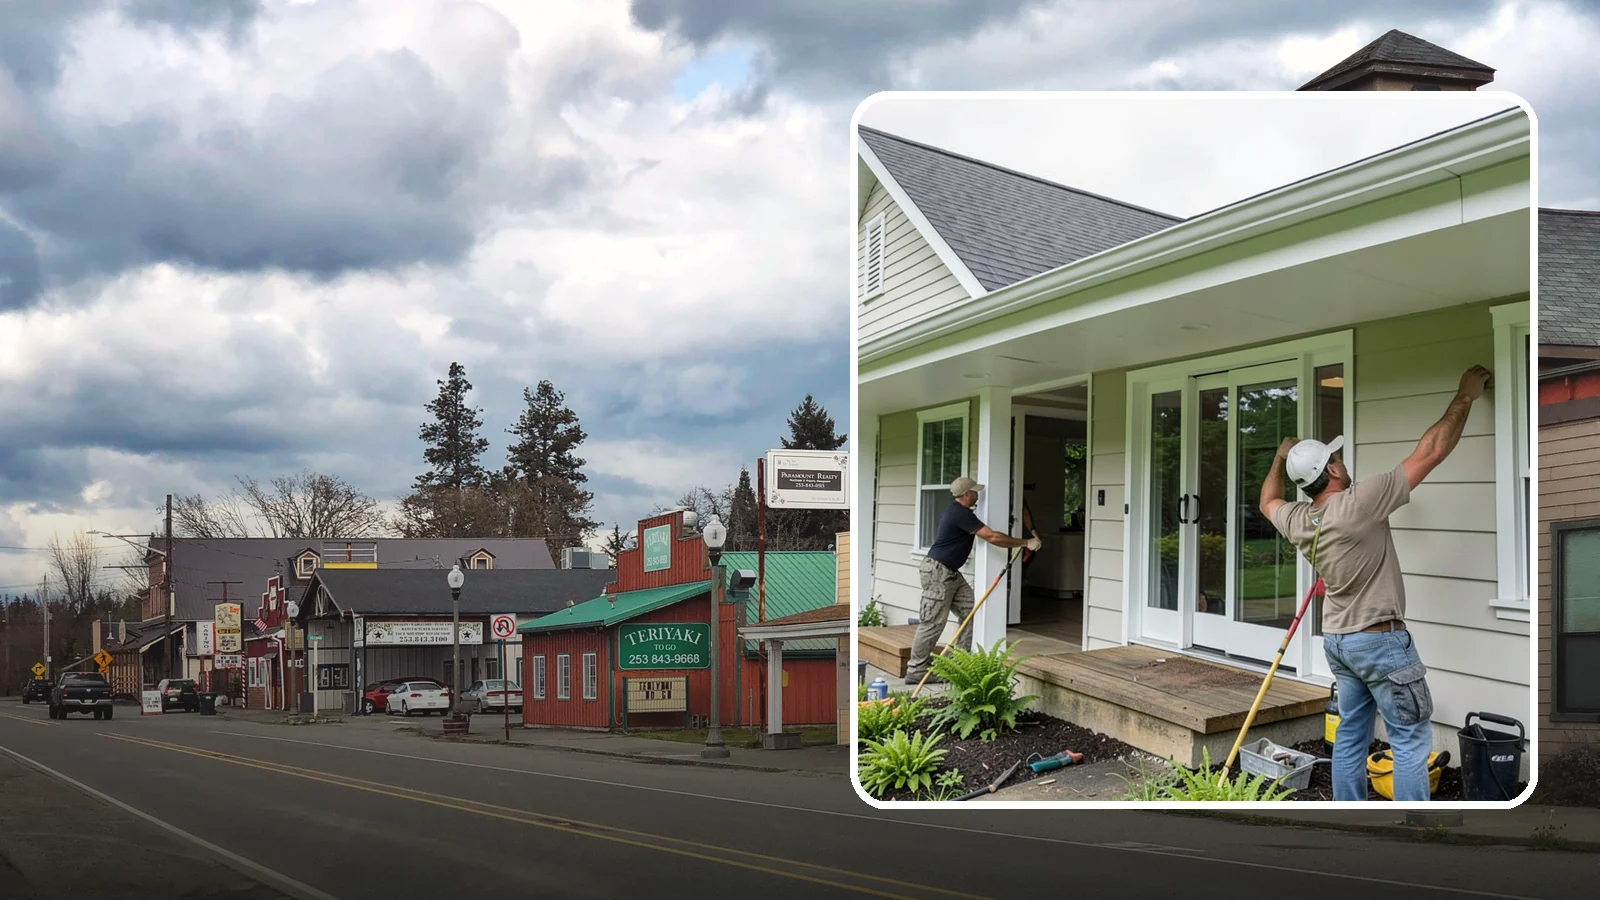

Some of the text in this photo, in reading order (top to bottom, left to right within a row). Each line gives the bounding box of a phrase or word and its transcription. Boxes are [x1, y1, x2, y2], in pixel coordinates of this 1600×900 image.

[781, 471, 839, 480] PARAMOUNT REALTY
[625, 627, 702, 646] TERIYAKI
[629, 654, 700, 665] 253 843-9668
[639, 681, 672, 691] TERIYAKI
